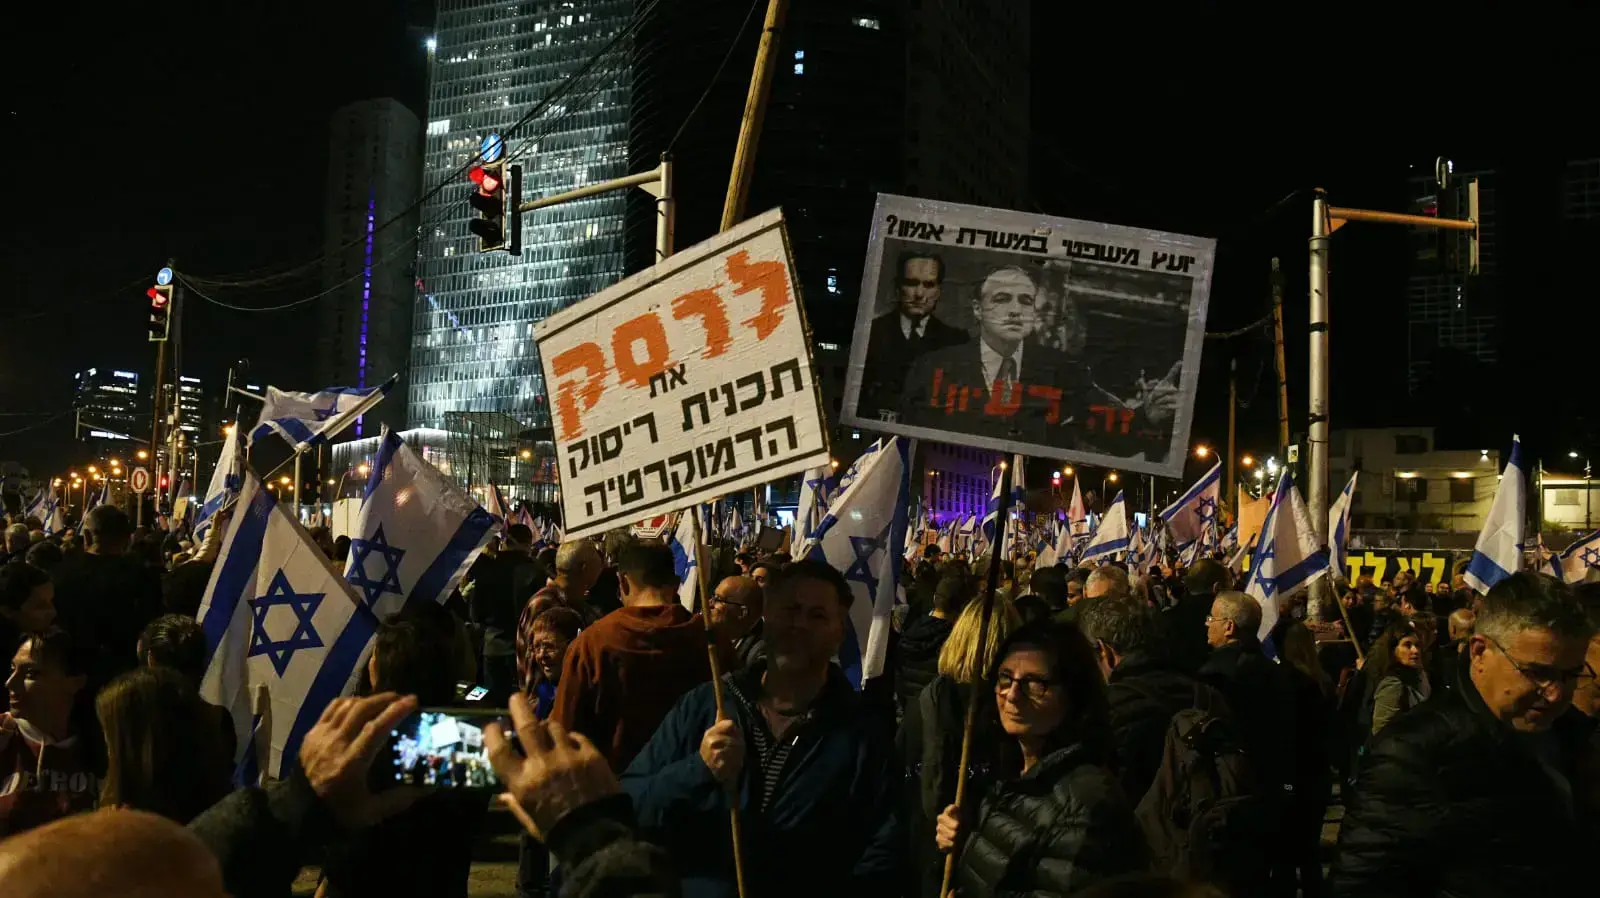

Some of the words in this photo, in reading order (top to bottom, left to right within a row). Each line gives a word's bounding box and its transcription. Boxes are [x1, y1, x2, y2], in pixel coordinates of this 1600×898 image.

[886, 214, 945, 242] אמון?
[956, 226, 1049, 254] במשרת
[1062, 240, 1140, 266] משפטי
[1151, 251, 1195, 272] יועץ
[552, 250, 793, 441] לרסק
[648, 363, 688, 398] את
[681, 357, 804, 432] תכנית
[567, 412, 659, 478] ריסוק
[584, 415, 798, 516] הדמוקרטיה
